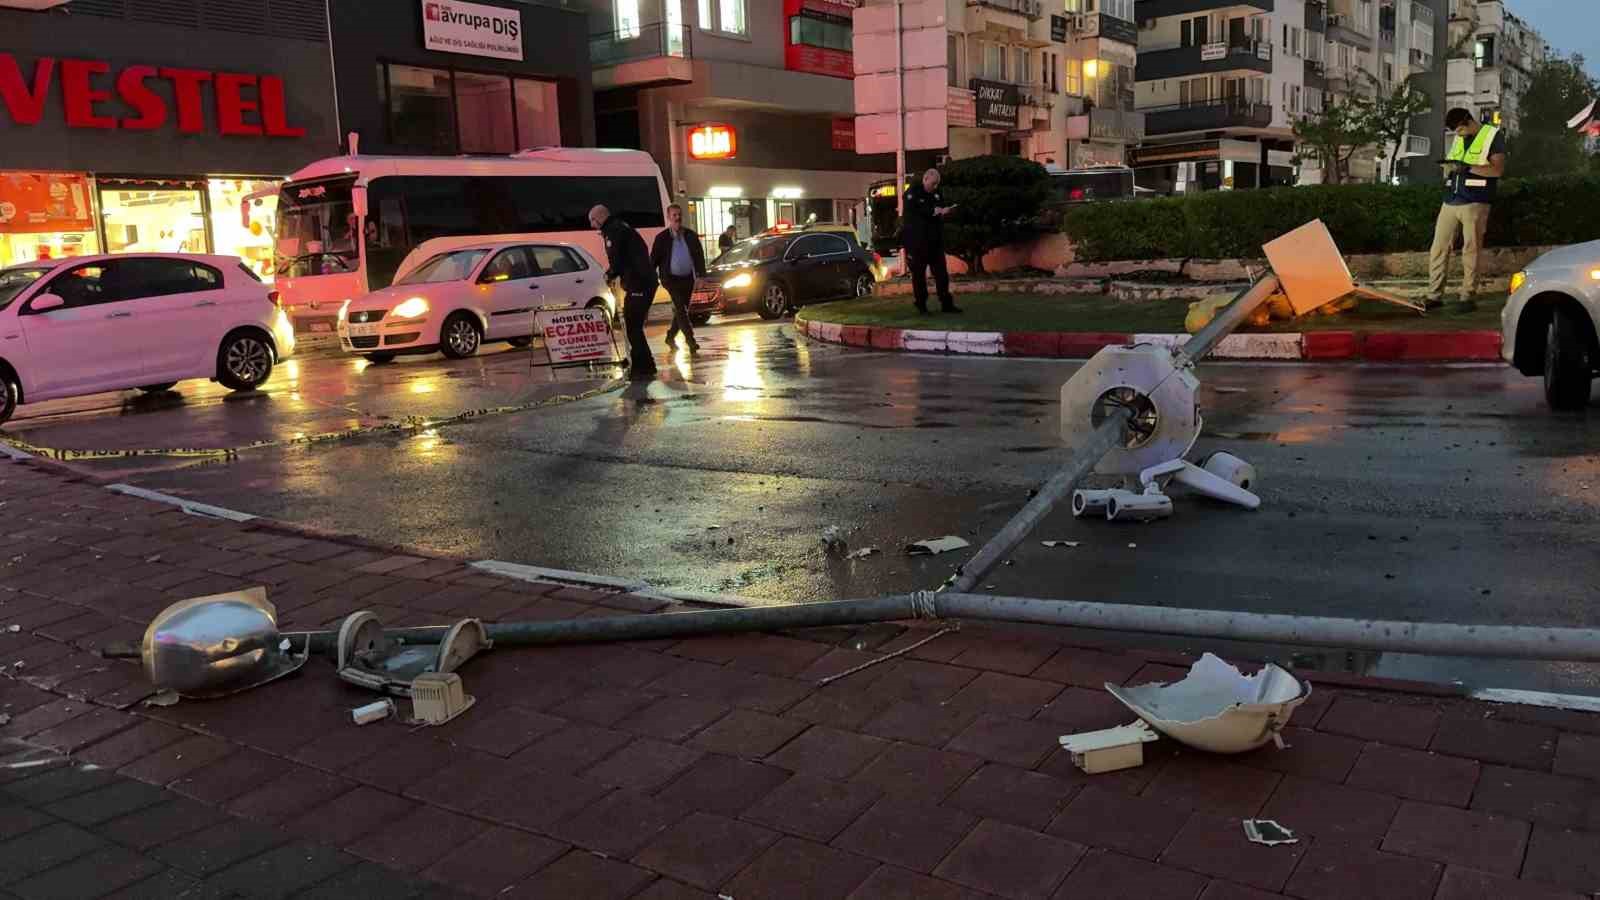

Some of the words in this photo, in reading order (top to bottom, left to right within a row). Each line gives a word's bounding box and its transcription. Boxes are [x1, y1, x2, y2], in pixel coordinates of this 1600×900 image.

[441, 10, 490, 30] avrupa
[0, 53, 305, 136] VESTEL
[546, 321, 604, 337] ECZANE
